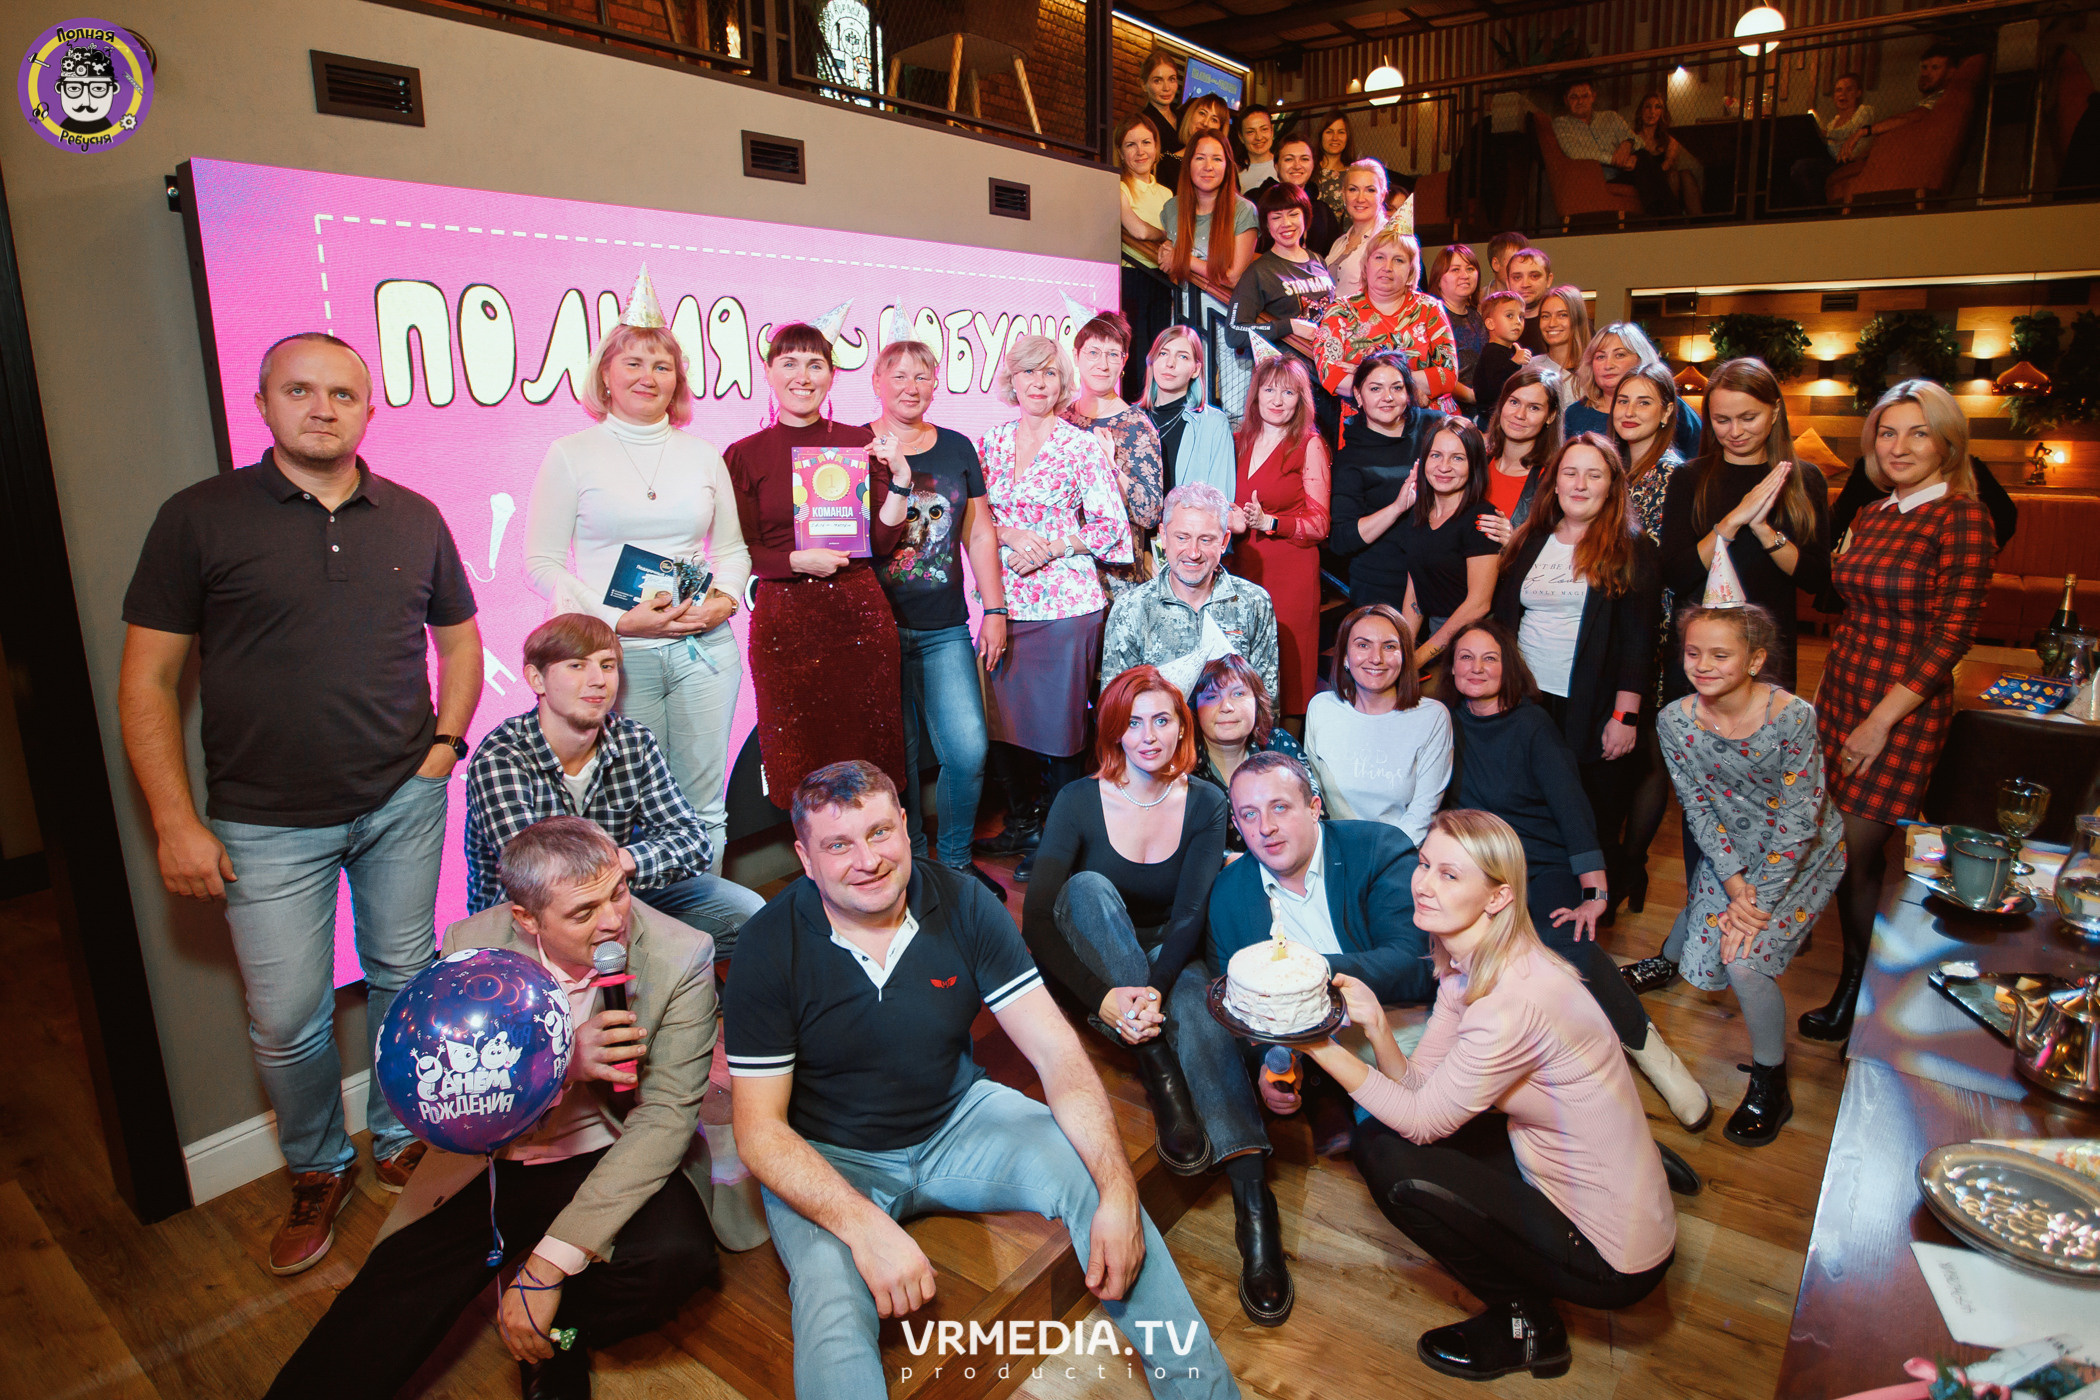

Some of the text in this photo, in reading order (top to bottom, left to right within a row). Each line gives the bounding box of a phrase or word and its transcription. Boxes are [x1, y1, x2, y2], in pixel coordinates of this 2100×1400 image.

[1282, 280, 1309, 296] STAY
[812, 506, 854, 518] КОМАНДА
[1352, 757, 1403, 789] things
[439, 1067, 512, 1100] ДНЁМ
[418, 1091, 516, 1124] РОЖДЕНИЯ
